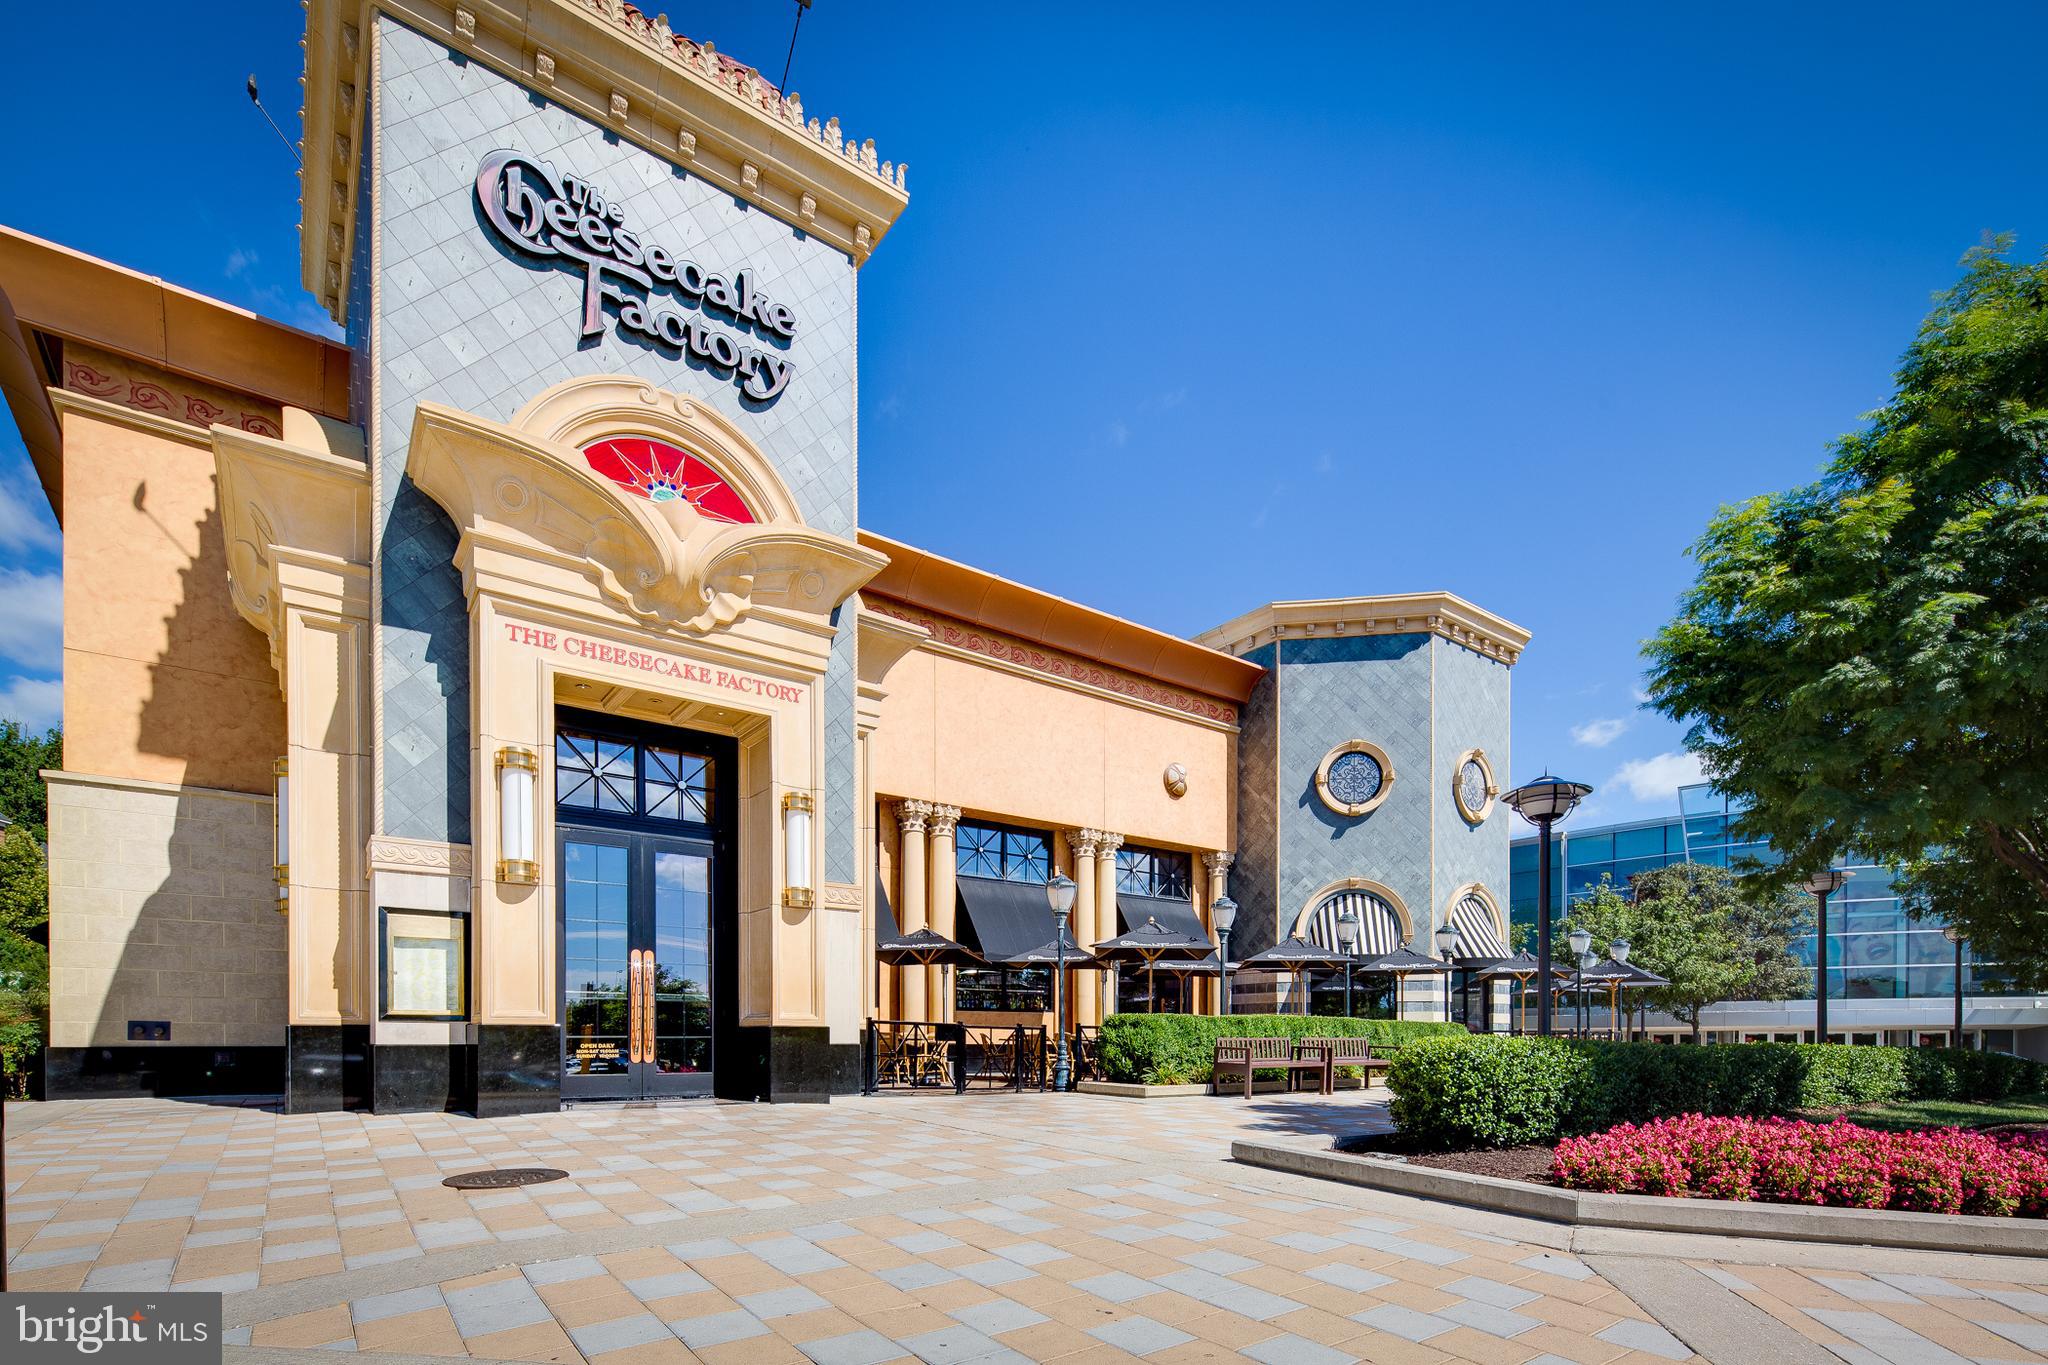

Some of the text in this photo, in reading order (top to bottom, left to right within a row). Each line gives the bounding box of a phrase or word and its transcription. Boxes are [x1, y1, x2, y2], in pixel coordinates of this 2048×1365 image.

[475, 148, 797, 338] Cheesecake
[561, 173, 626, 224] The
[550, 234, 797, 400] Factory
[505, 623, 804, 704] THE CHEESECAKE FACTORY
